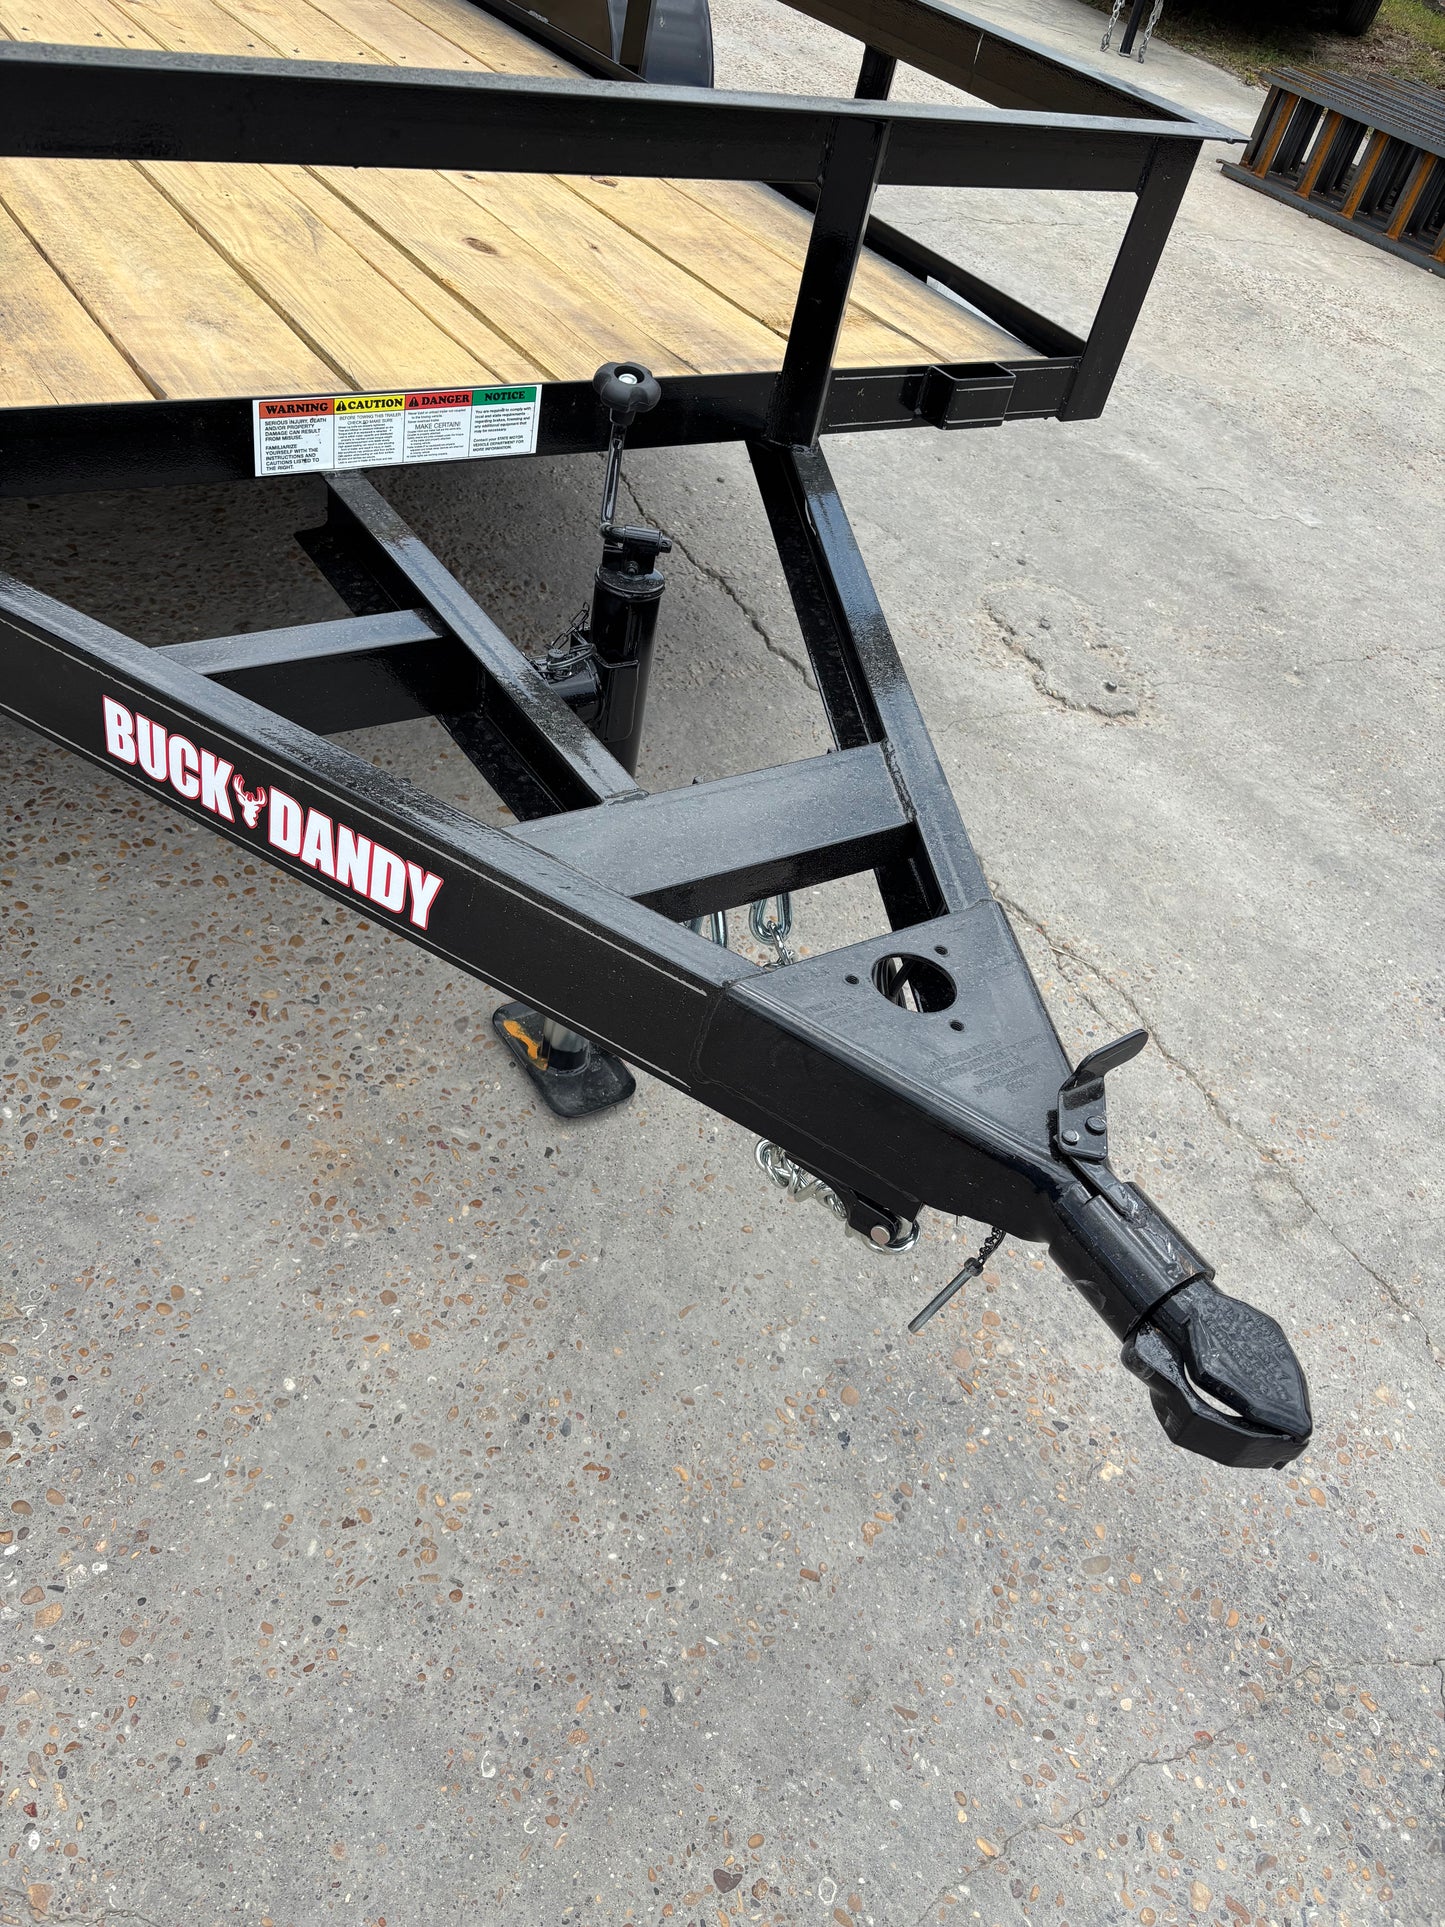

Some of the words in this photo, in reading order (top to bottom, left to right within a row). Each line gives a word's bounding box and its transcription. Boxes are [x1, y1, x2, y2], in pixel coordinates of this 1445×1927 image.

[421, 394, 470, 405] DANGER
[484, 391, 525, 401] NOTICE
[265, 402, 328, 415] WARNING
[347, 398, 403, 410] CAUTION
[102, 695, 235, 824] BUCK
[268, 785, 444, 931] DANDY
